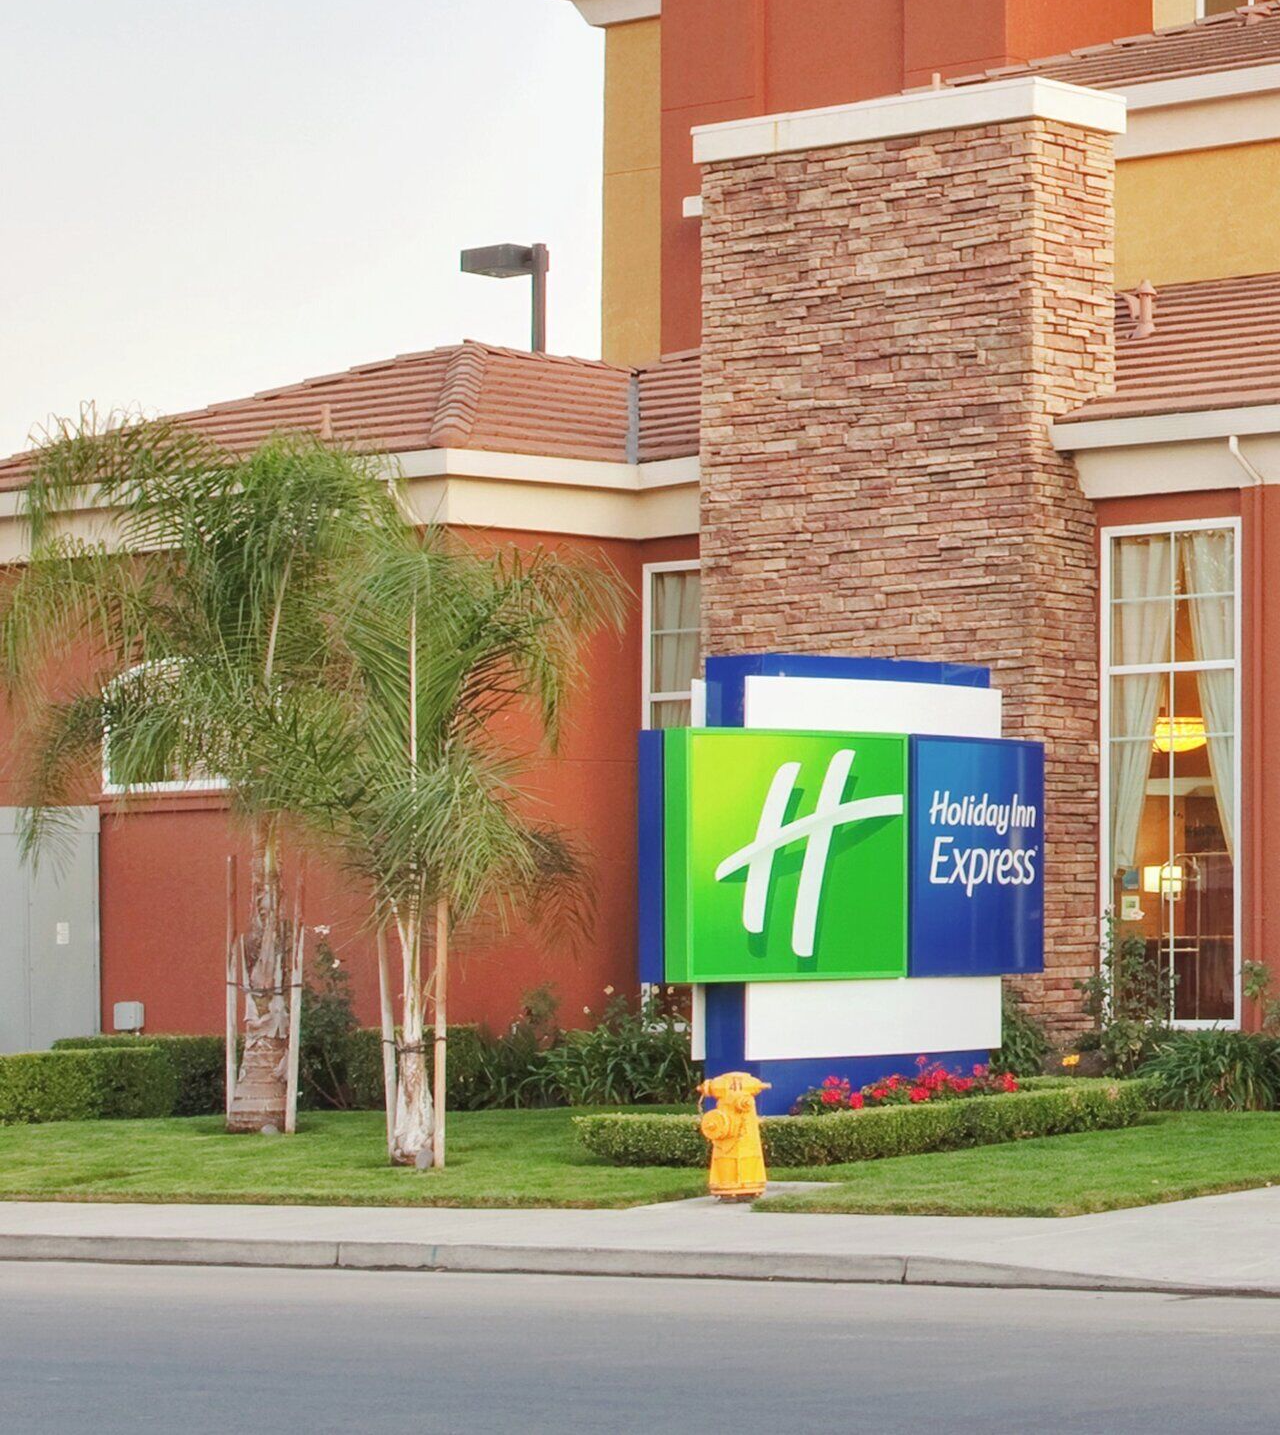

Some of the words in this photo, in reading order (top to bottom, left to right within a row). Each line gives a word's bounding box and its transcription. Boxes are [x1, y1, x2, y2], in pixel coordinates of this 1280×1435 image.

[929, 790, 1011, 835] Holiday
[1011, 793, 1036, 828] Inn
[930, 836, 1037, 897] Express
